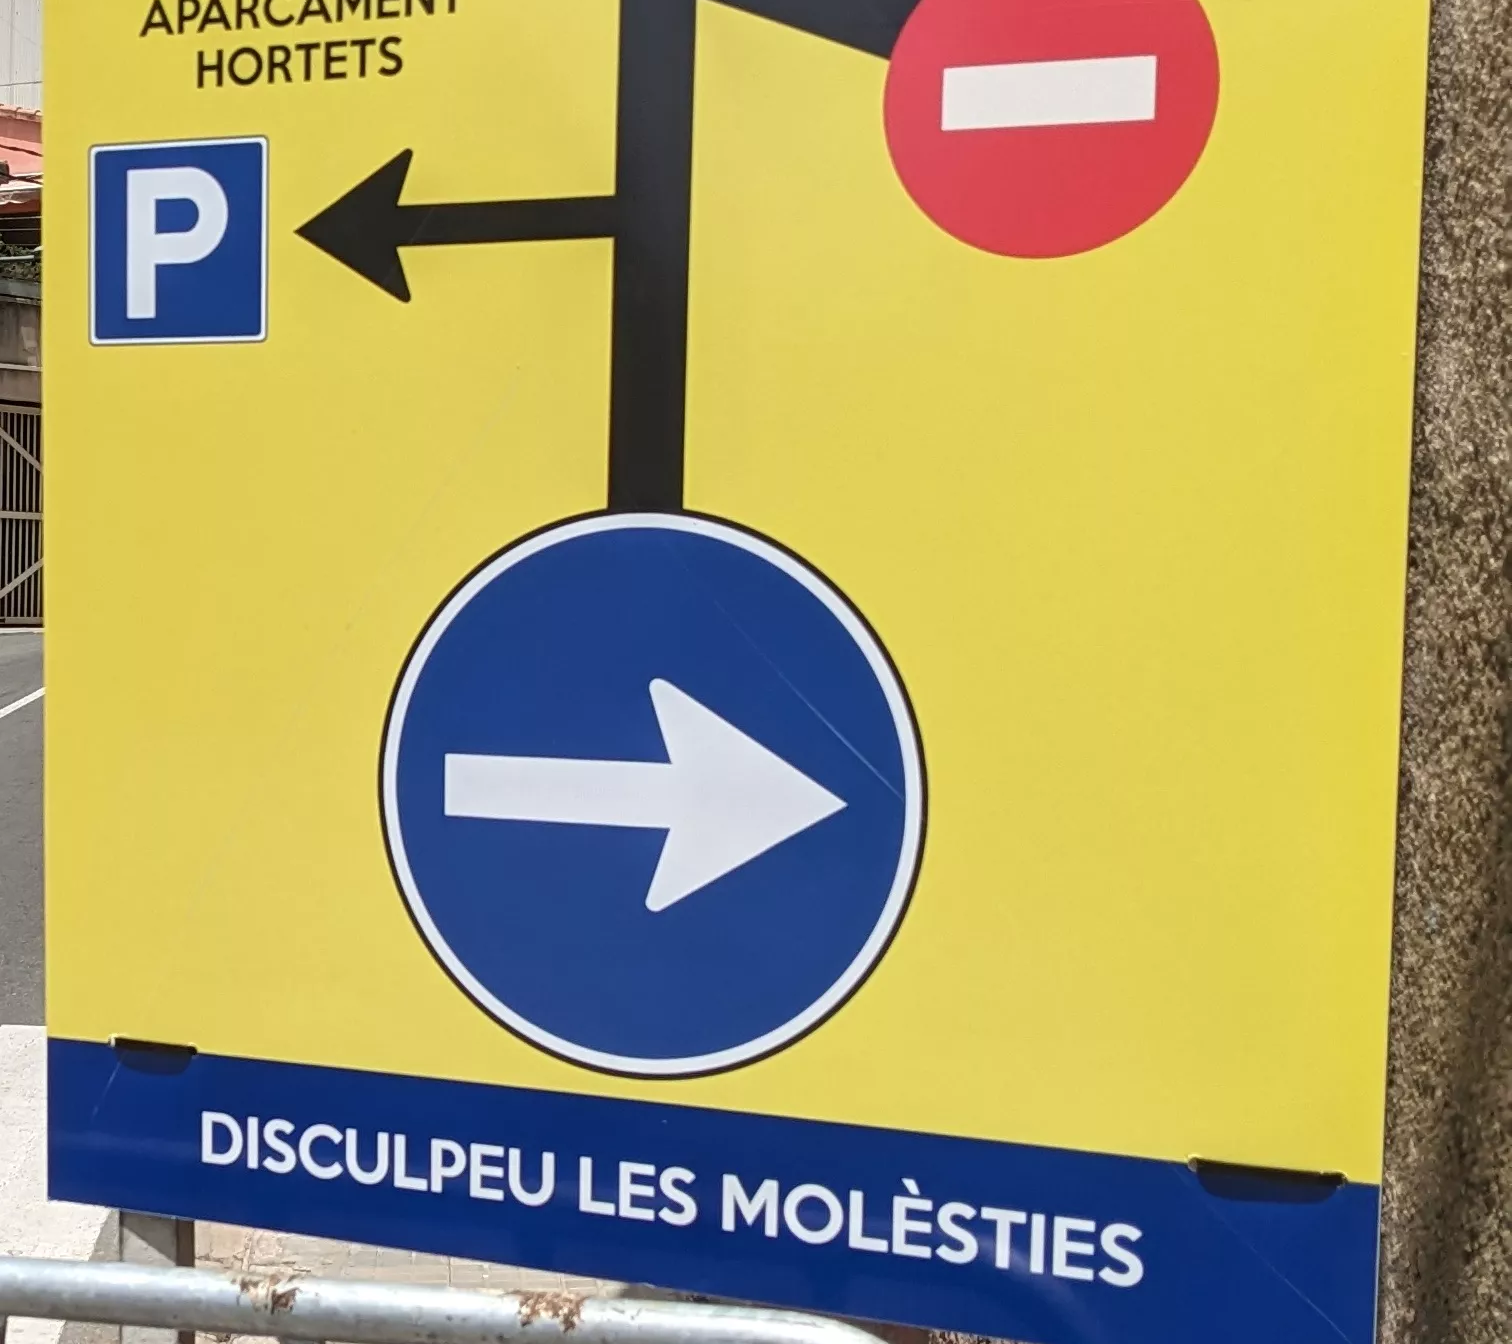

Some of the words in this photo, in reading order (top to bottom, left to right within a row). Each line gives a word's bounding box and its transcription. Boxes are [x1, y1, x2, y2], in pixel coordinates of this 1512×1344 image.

[196, 36, 404, 89] HORTETS
[126, 166, 228, 320] P
[200, 1111, 556, 1206] DISCULPEU
[578, 1155, 698, 1227] LES
[721, 1175, 1144, 1288] MOLÈSTIES
